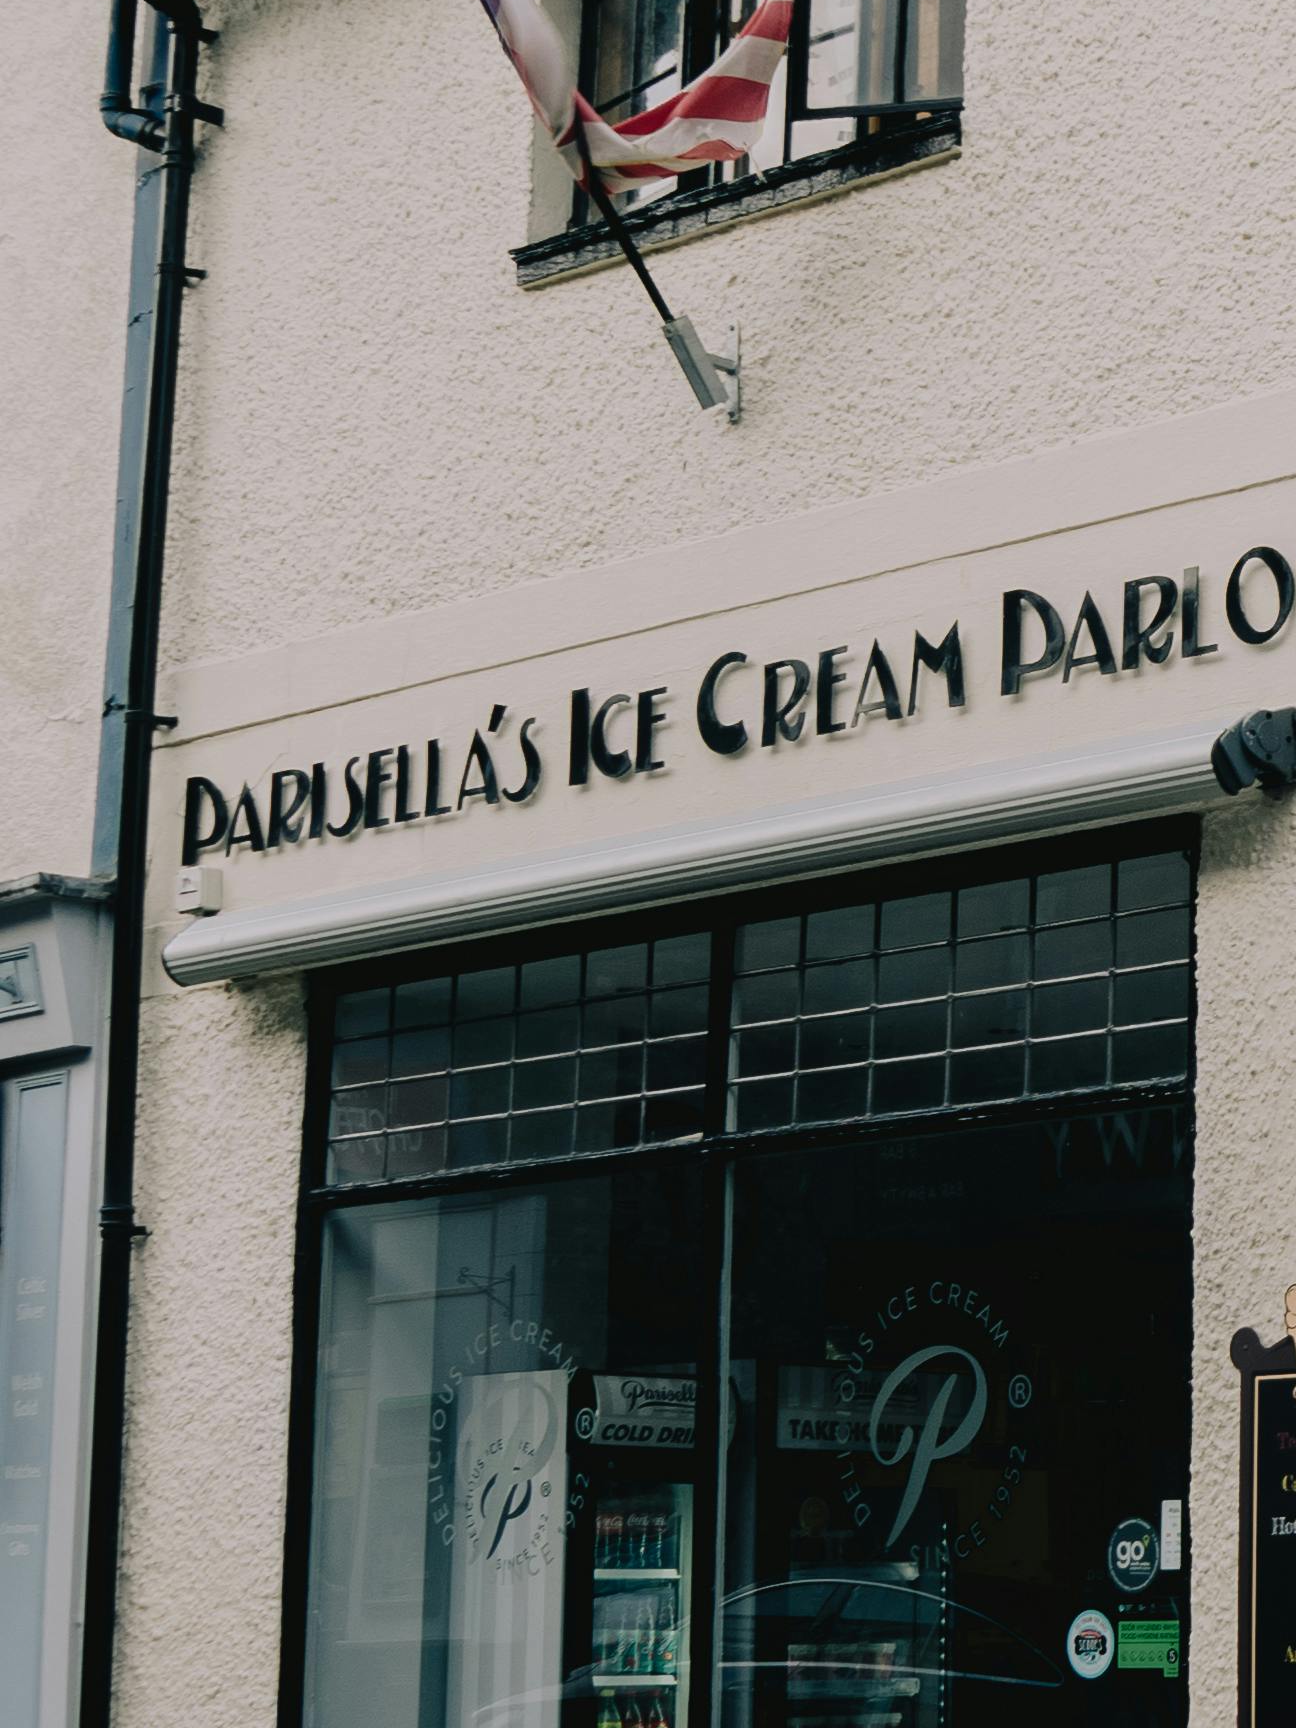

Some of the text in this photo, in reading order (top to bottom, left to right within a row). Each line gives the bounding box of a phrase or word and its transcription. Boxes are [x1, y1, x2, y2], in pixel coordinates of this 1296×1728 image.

[183, 704, 540, 865] PARISELLA'S
[569, 685, 668, 786] ICE
[698, 619, 964, 755] CREAM
[427, 1319, 579, 1545] DELICIOUS ICE CREAM
[602, 1424, 653, 1442] COLD
[837, 1332, 873, 1526] DELICIOUS
[877, 1286, 917, 1329] ICE
[929, 1281, 1009, 1348] CREAM
[910, 1445, 1027, 1569] SINCE 1952
[1116, 1540, 1145, 1569] go
